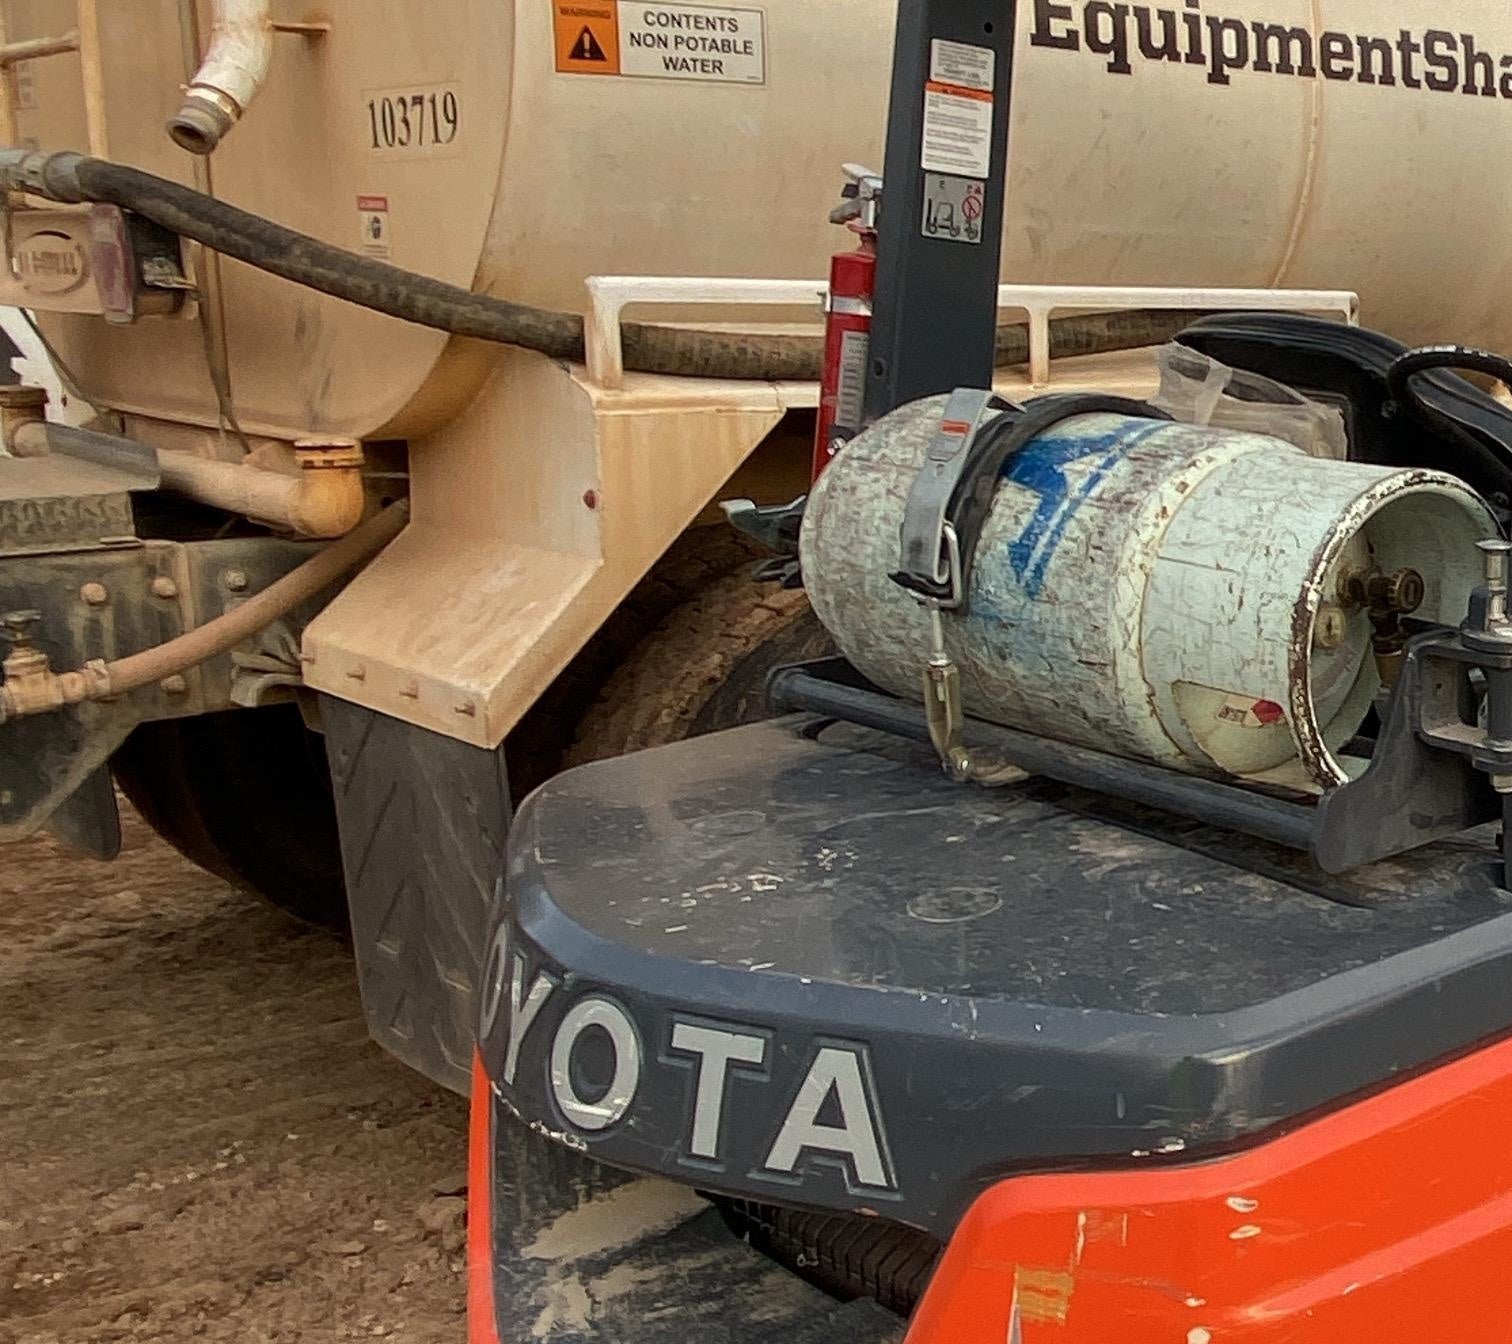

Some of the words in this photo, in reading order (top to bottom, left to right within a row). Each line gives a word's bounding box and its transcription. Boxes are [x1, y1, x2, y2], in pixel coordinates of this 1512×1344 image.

[643, 10, 739, 34] CONTENTS
[629, 31, 669, 50] NON
[673, 34, 754, 57] POTABLE
[661, 56, 724, 75] WATER
[368, 90, 458, 149] 103719
[479, 914, 898, 1188] OYOTA
